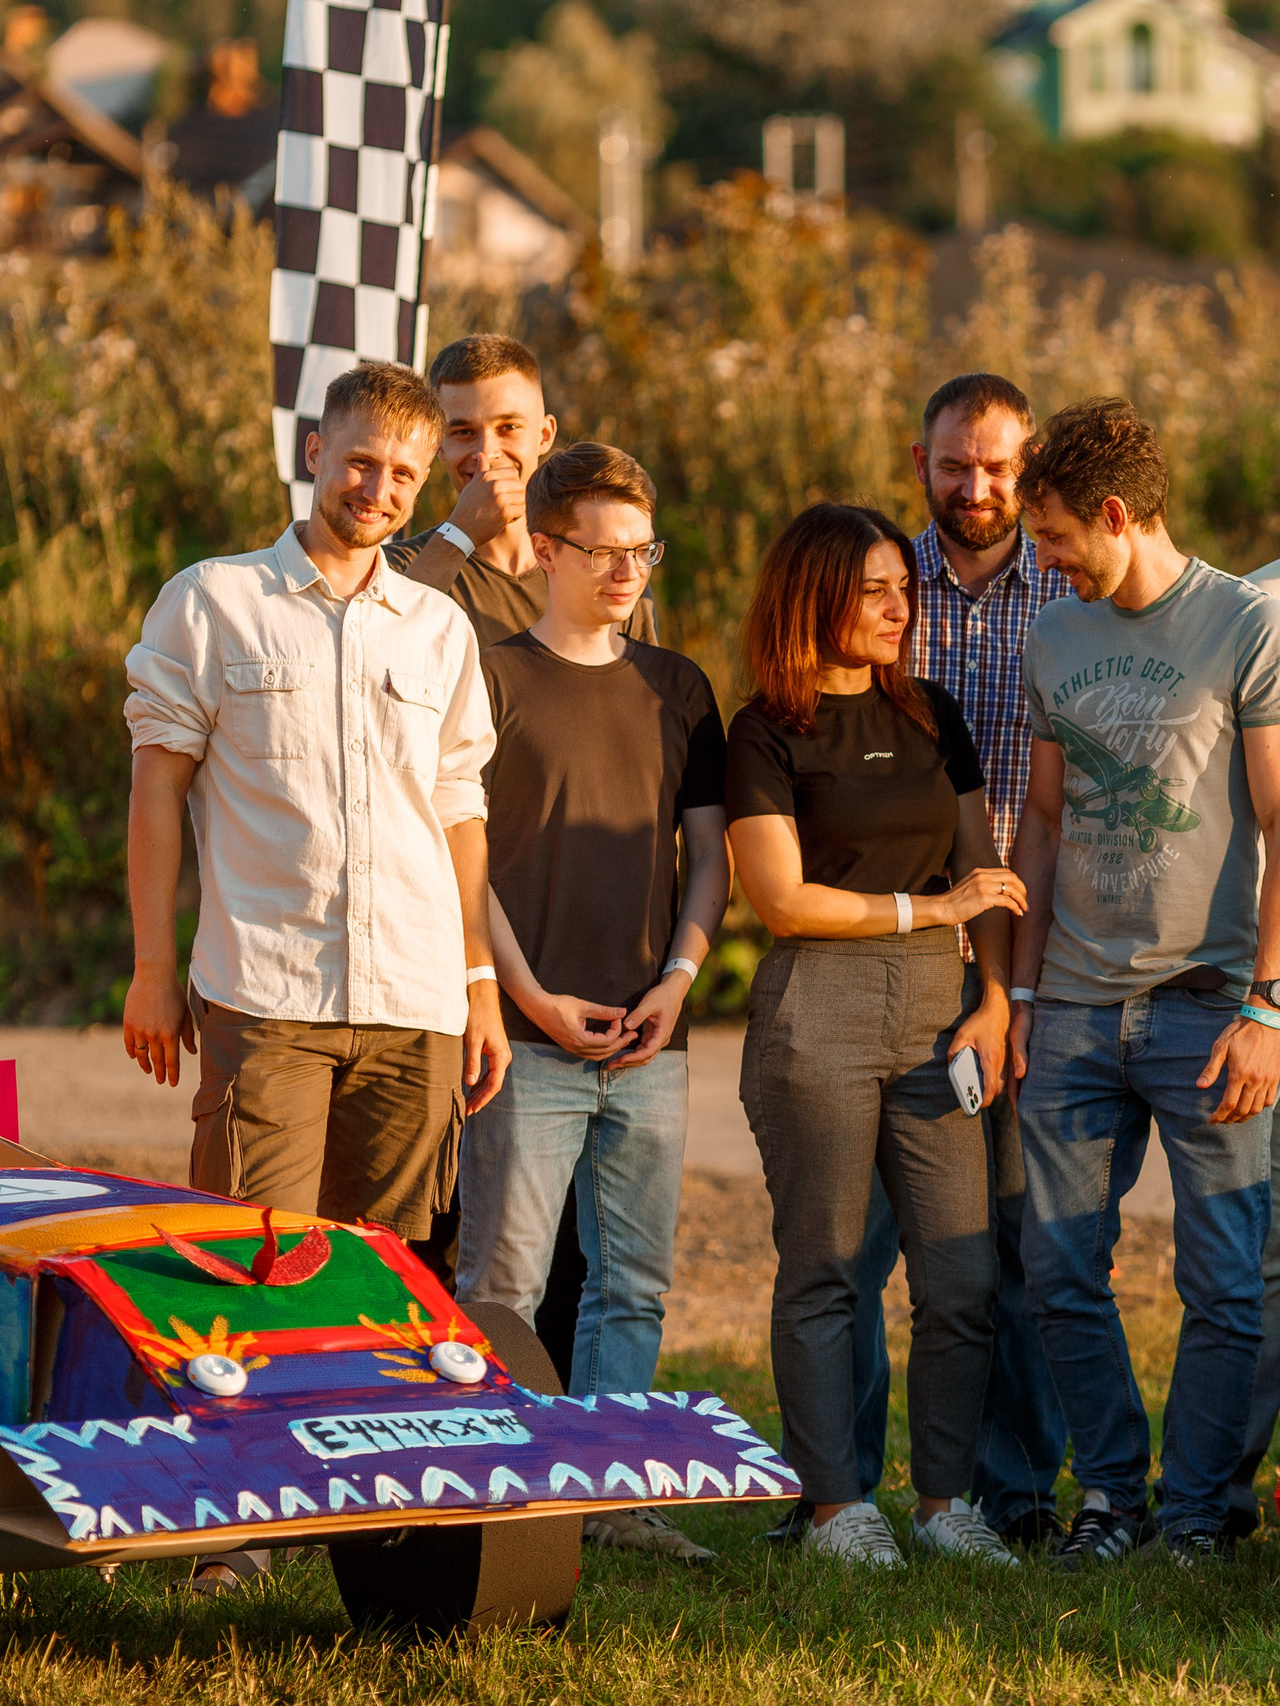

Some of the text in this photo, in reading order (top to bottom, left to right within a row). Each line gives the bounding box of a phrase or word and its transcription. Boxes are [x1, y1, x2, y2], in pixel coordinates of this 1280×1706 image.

[1052, 655, 1185, 710] ATHLETIC DEPT.
[1075, 682, 1167, 720] Born
[1124, 718, 1178, 770] fly
[1068, 830, 1135, 847] AVIATOR DIVISION
[1073, 842, 1180, 893] SKY ADVENTURE
[1097, 852, 1124, 864] 1982
[1096, 893, 1123, 905] VINTAGE
